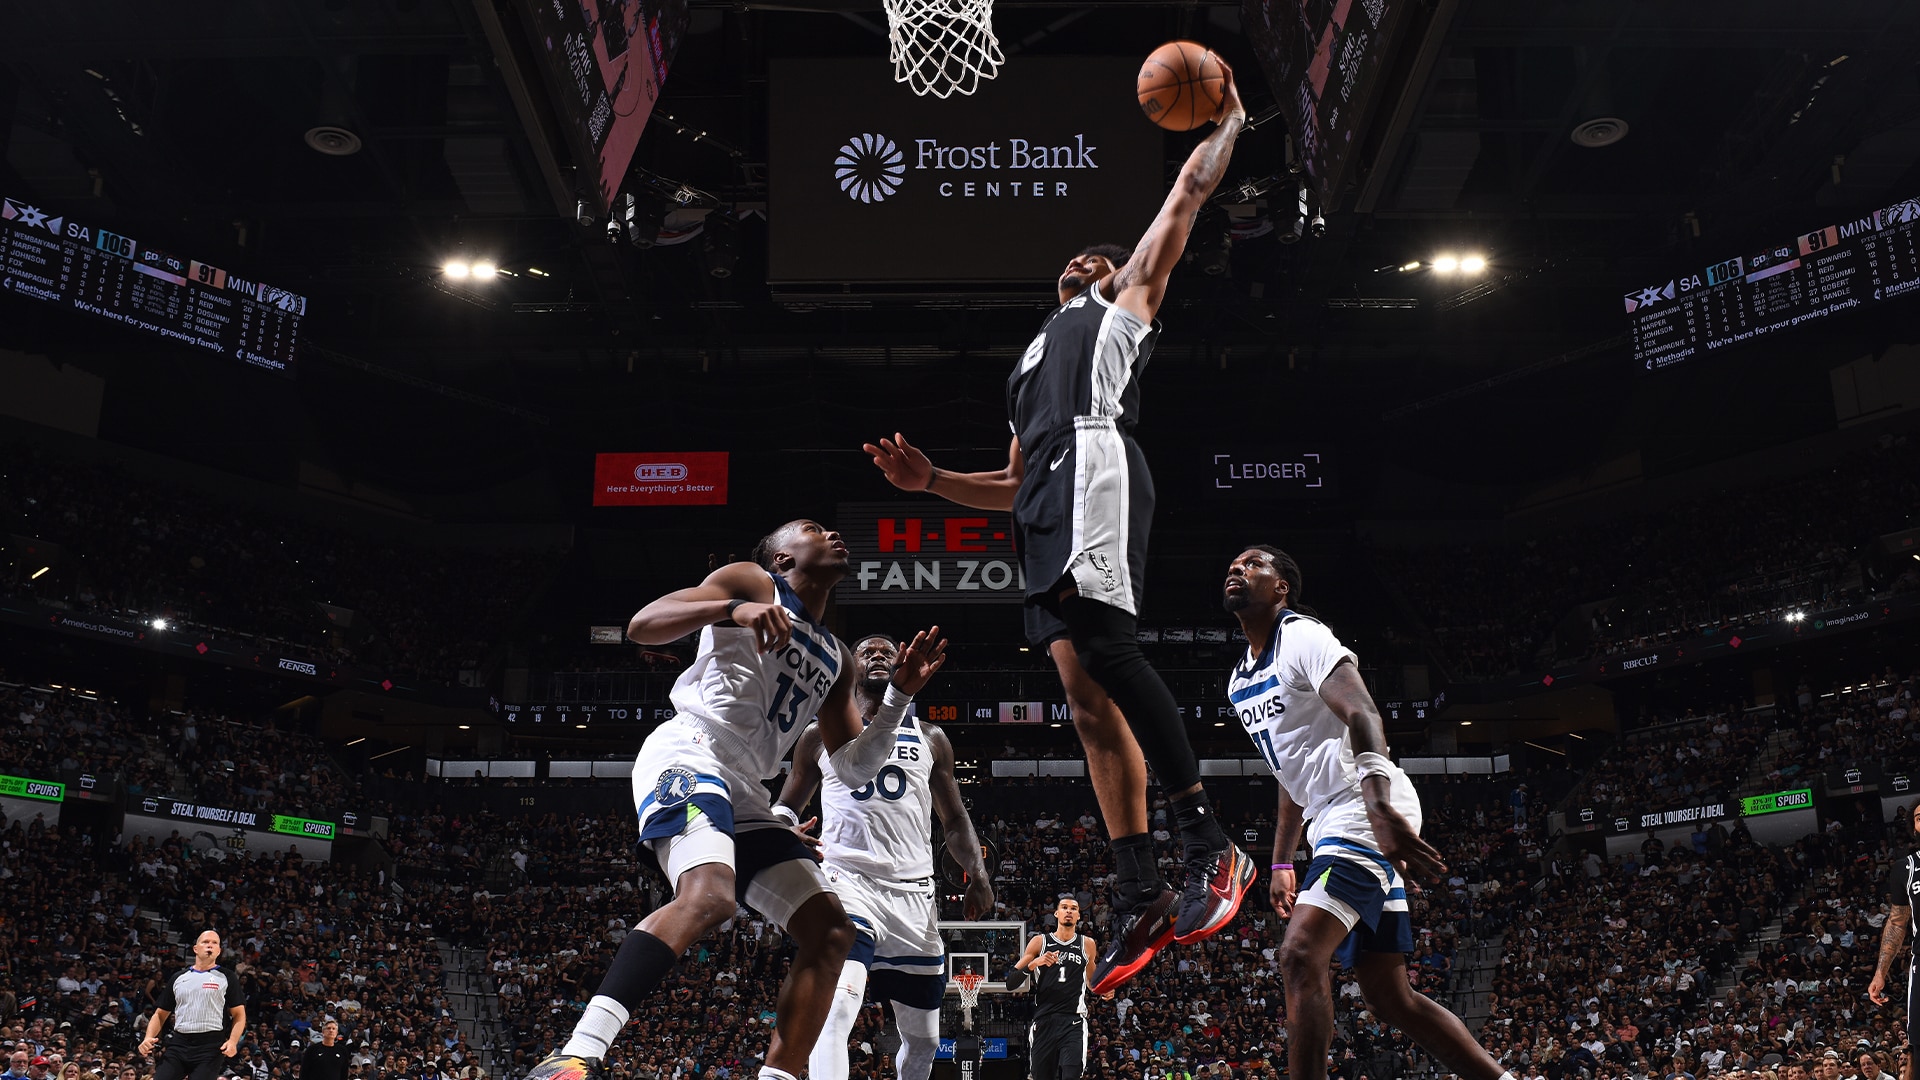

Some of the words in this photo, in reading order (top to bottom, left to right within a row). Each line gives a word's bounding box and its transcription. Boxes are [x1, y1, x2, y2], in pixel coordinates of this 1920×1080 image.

[574, 32, 592, 76] SONG
[1338, 32, 1356, 76] SONG
[564, 32, 590, 106] REQUESTS
[1340, 29, 1368, 102] REQUESTS
[915, 139, 1000, 169] Frost
[1009, 134, 1098, 169] Bank
[939, 182, 1068, 197] CENTER
[12, 240, 42, 254] HARPER
[14, 231, 60, 251] WEMBANYAMA
[10, 250, 46, 266] JOHNSON
[67, 222, 90, 242] SA
[102, 232, 131, 256] 106
[199, 265, 216, 285] 91
[228, 276, 256, 296] MIN
[1680, 274, 1702, 292] SA
[1711, 260, 1740, 284] 106
[1808, 230, 1828, 251] 91
[1840, 216, 1872, 239] MIN
[1816, 249, 1852, 267] EDWARDS
[8, 257, 24, 268] FOX
[1818, 264, 1834, 275] REID
[6, 266, 54, 287] CHAMPAGNIE
[1820, 267, 1856, 284] DOSUNMU
[16, 280, 61, 301] Methodist
[1822, 278, 1850, 293] GOBERT
[200, 291, 232, 306] EDWARDS
[1823, 287, 1850, 301] RANDLE
[198, 299, 214, 310] REID
[196, 316, 222, 330] GOBERT
[197, 308, 230, 324] DOSUNMU
[1706, 336, 1733, 350] We're
[1734, 330, 1754, 342] here
[1755, 326, 1768, 335] for
[1770, 320, 1790, 332] your
[1792, 308, 1828, 326] growing
[1830, 298, 1861, 313] family.
[74, 298, 101, 314] We're
[102, 307, 122, 322] here
[124, 314, 138, 325] for
[138, 320, 160, 332] your
[160, 328, 196, 345] growing
[196, 336, 225, 353] family.
[194, 324, 220, 338] RANDLE
[1641, 318, 1666, 332] HARPER
[1642, 325, 1674, 340] JOHNSON
[1645, 338, 1686, 357] CHAMPAGNIE
[1656, 347, 1695, 364] Methodist
[246, 352, 286, 370] Methodist
[1230, 464, 1306, 480] LEDGER
[630, 484, 684, 494] Everything's
[686, 484, 714, 492] Better
[878, 518, 1016, 552] H-E-
[857, 561, 940, 590] FAN
[61, 617, 98, 632] Americus
[98, 623, 134, 638] Diamond
[1826, 611, 1870, 628] imagine360
[768, 643, 831, 699] WOLVES
[1623, 657, 1652, 670] RBFCU
[766, 672, 808, 733] 13
[508, 714, 516, 722] 42
[536, 714, 542, 722] 19
[562, 714, 566, 722] 8
[586, 714, 591, 722] 7
[608, 709, 628, 719] TO
[636, 708, 642, 720] 3
[654, 709, 678, 720] FG
[928, 706, 957, 720] 5:30
[976, 708, 992, 718] 4TH
[1012, 705, 1028, 720] 91
[1196, 706, 1202, 718] 3
[1240, 695, 1286, 728] OLVES
[1392, 710, 1398, 719] 15
[28, 782, 60, 796] SPURS
[520, 796, 535, 806] 113
[1777, 792, 1807, 807] SPURS
[171, 802, 194, 817] STEAL
[196, 806, 232, 822] YOURSELF
[231, 812, 238, 823] A
[238, 812, 256, 826] DEAL
[1641, 811, 1664, 828] STEAL
[1664, 806, 1700, 824] YOURSELF
[1700, 807, 1708, 820] A
[1706, 804, 1724, 818] DEAL
[304, 822, 332, 835] SPURS
[228, 838, 245, 848] 112
[1068, 952, 1082, 965] RS
[1058, 966, 1066, 982] 1
[938, 1044, 956, 1052] Vic
[962, 1060, 974, 1070] GET
[962, 1071, 974, 1080] THE
